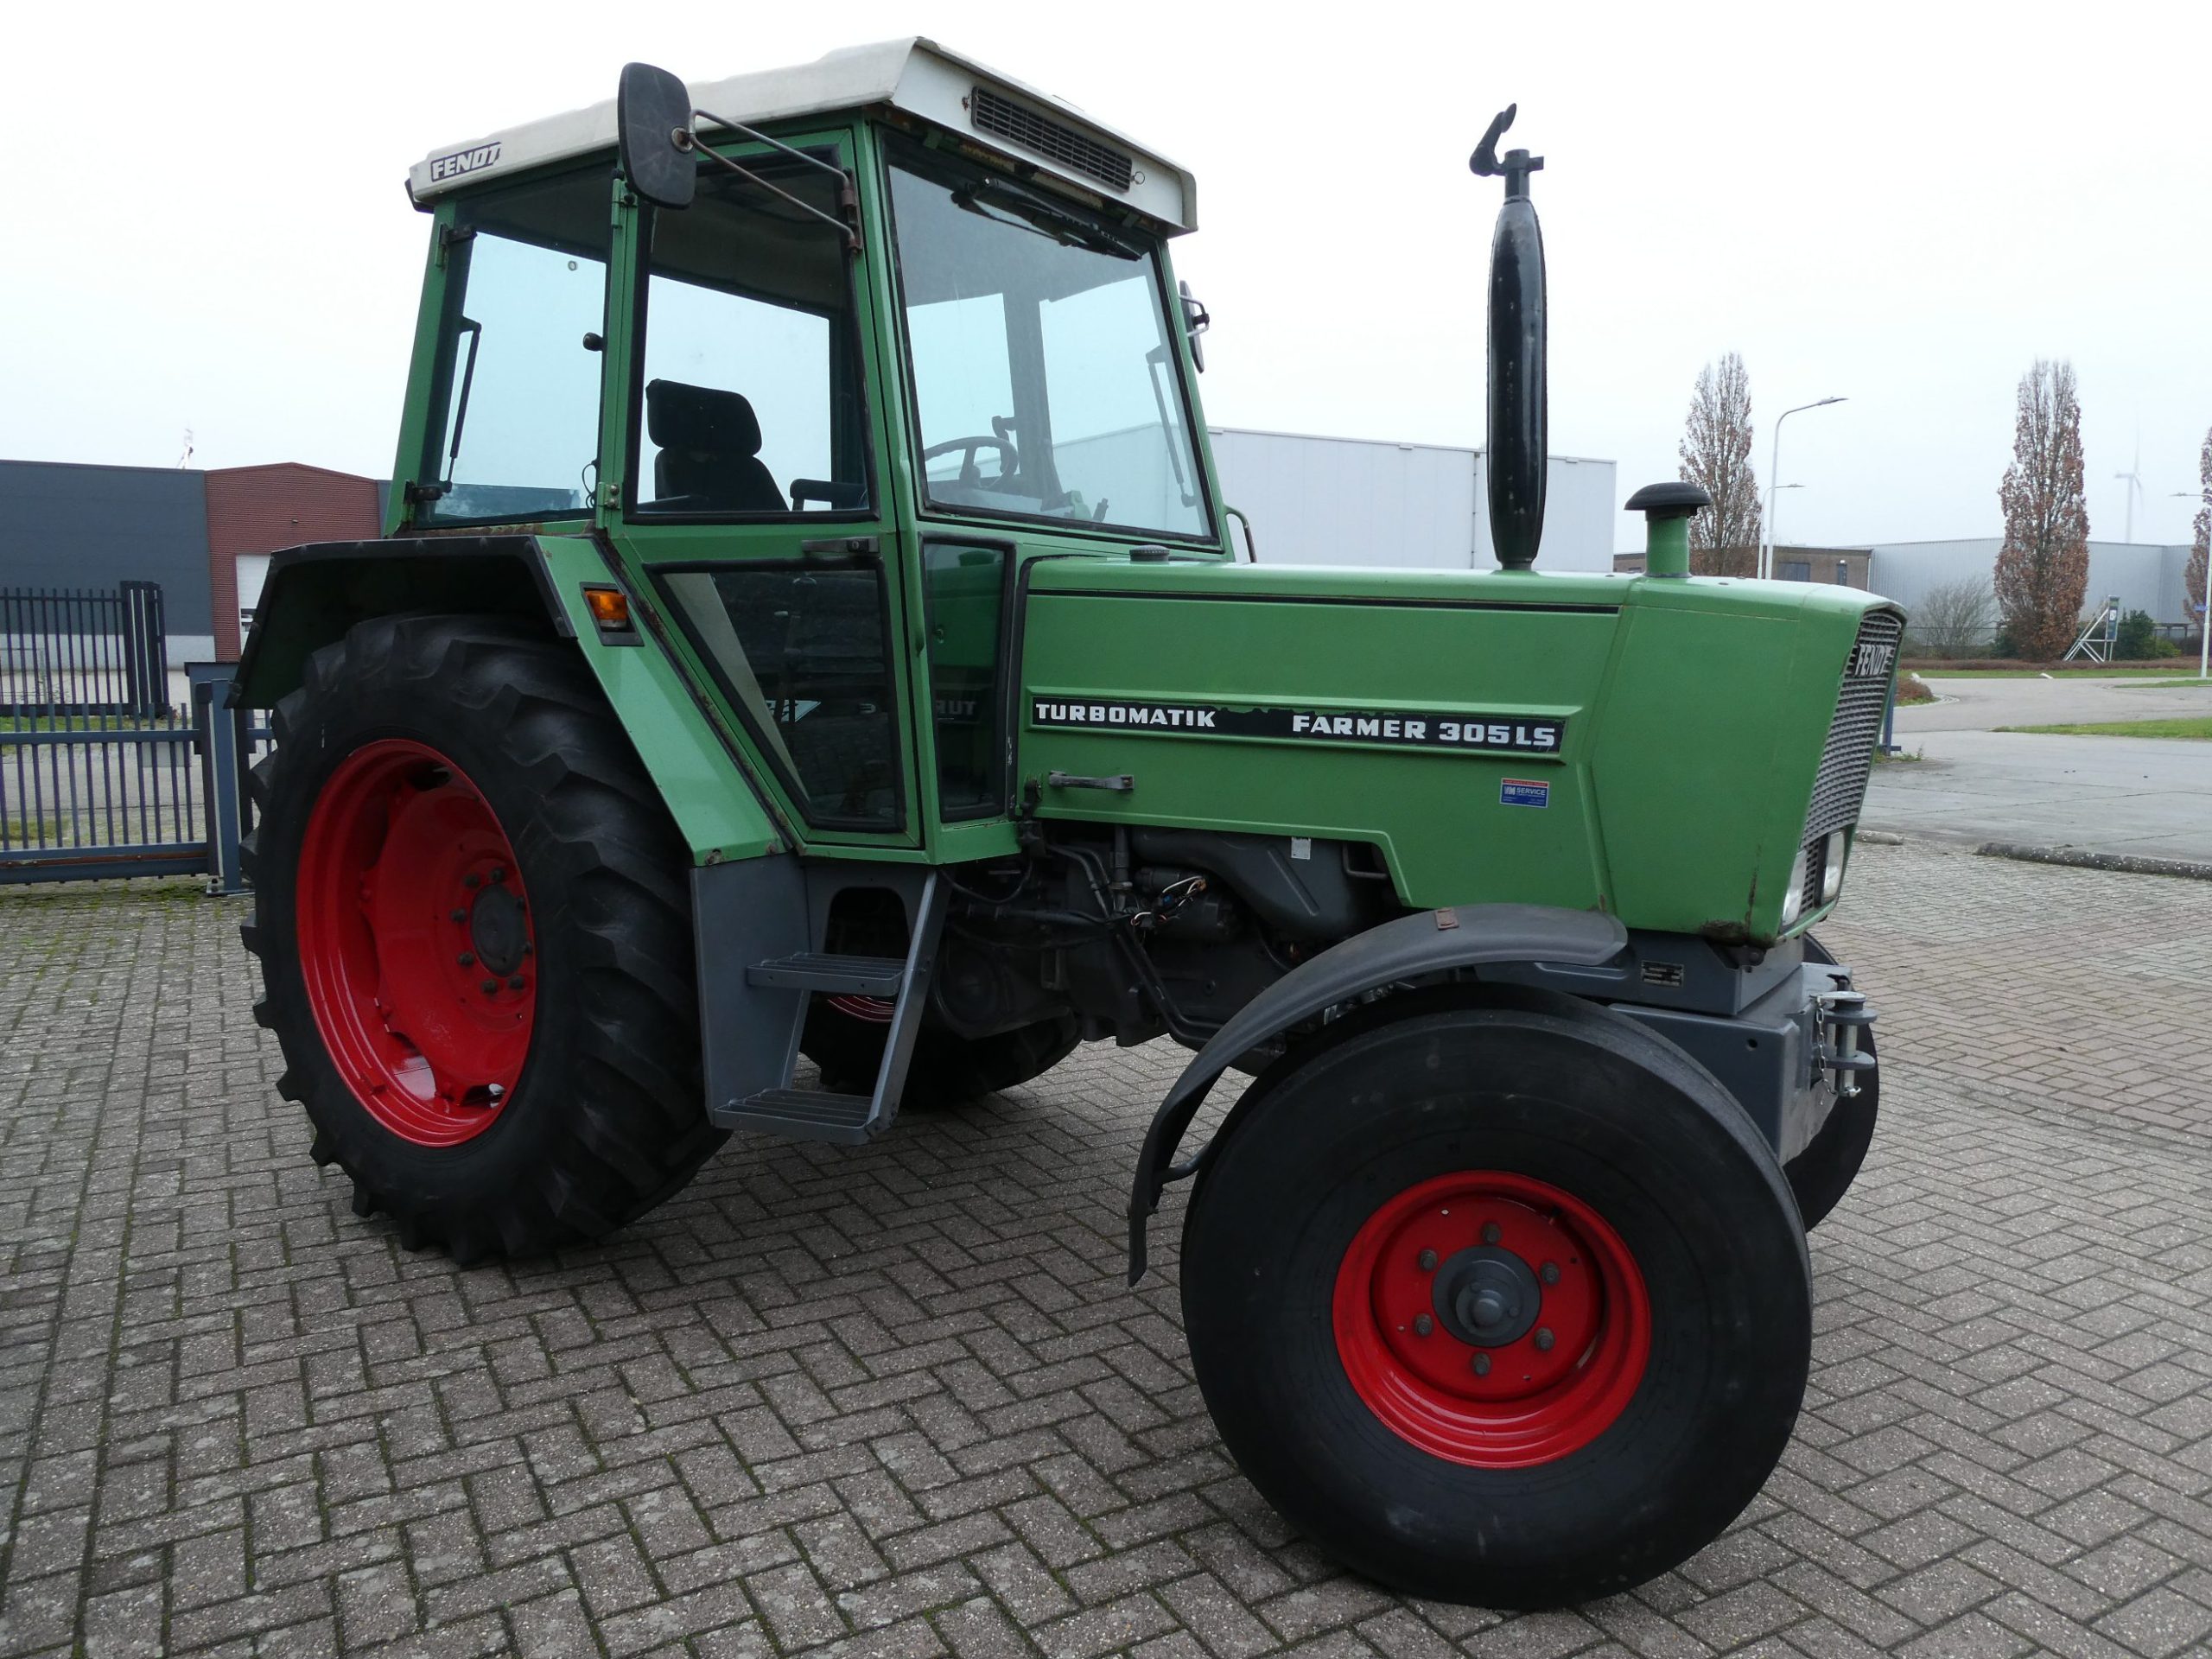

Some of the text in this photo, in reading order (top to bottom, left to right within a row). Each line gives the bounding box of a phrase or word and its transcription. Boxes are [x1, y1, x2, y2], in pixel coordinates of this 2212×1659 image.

[431, 143, 501, 181] FENDT
[1855, 644, 1894, 676] FENDT
[1036, 703, 1216, 728] TURBOMATIK
[1293, 715, 1426, 740] FARMER
[1516, 786, 1547, 796] SERVICE
